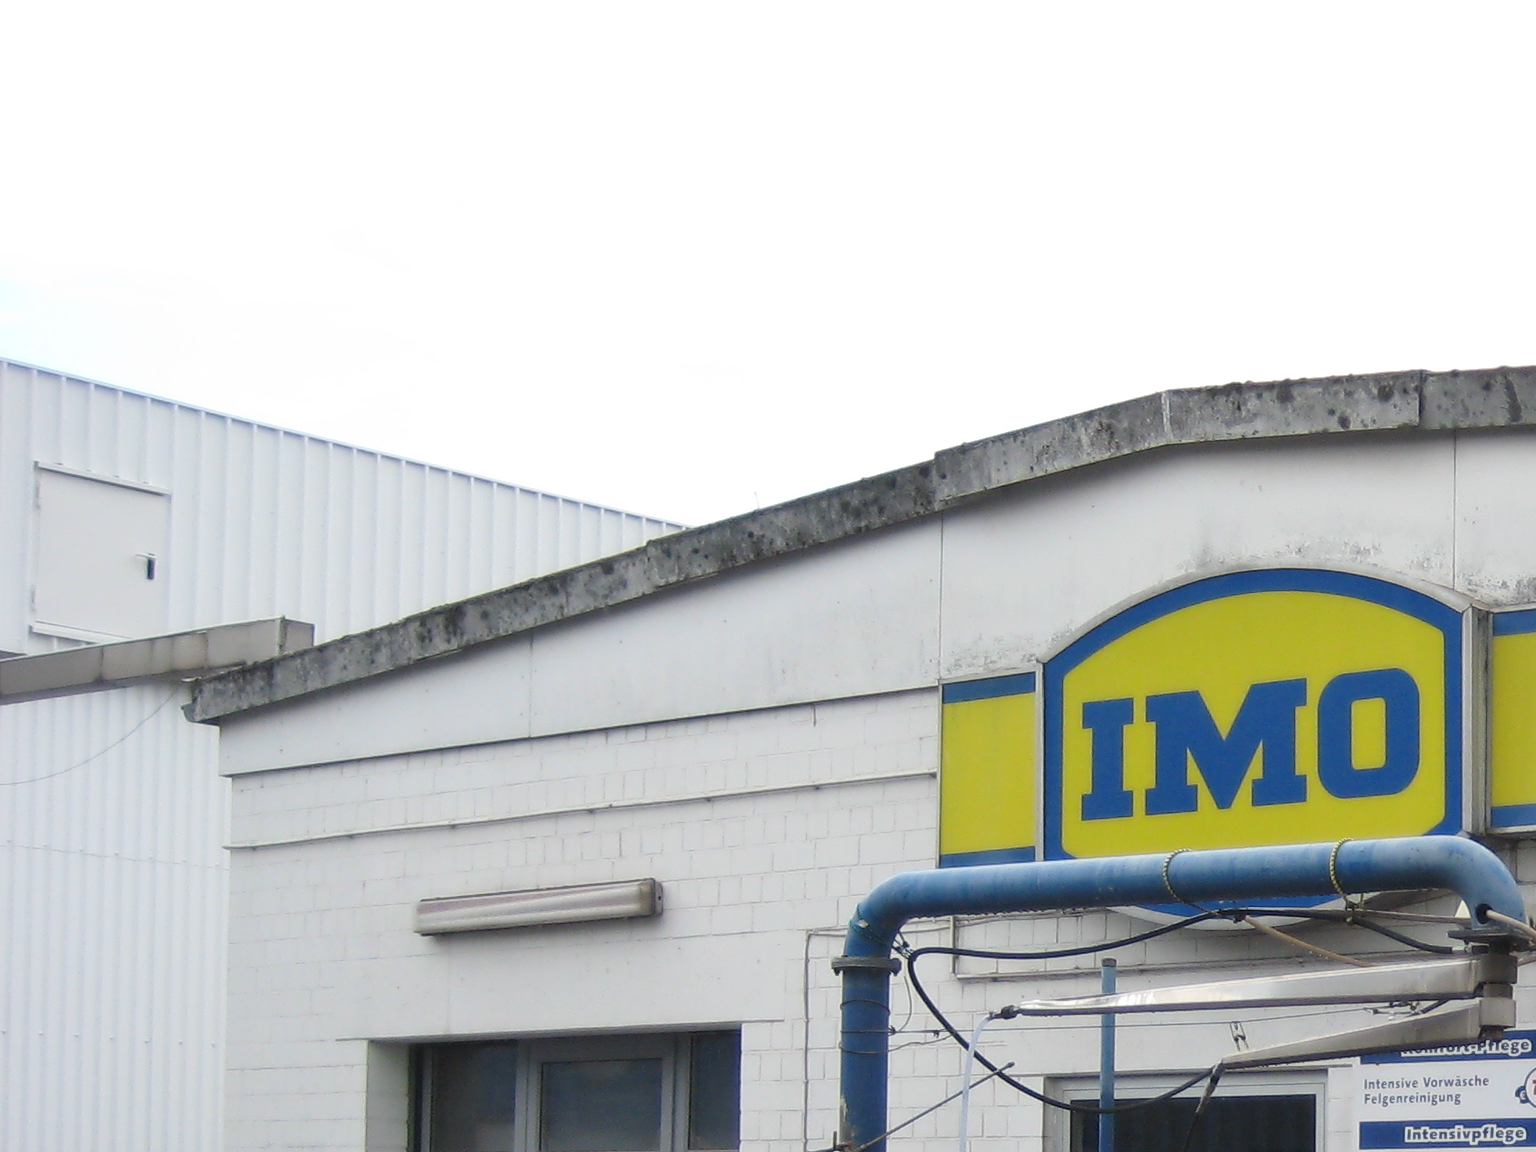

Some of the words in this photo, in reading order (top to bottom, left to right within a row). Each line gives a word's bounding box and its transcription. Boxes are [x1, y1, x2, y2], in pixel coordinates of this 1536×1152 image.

[1081, 667, 1420, 821] IMO
[1402, 1039, 1531, 1058] ort-Pflege
[1364, 1078, 1418, 1090] Intensive
[1423, 1076, 1490, 1088] Vorwäsche
[1364, 1093, 1461, 1107] Felgenreinigung
[1406, 1127, 1525, 1143] Intensivpflege
